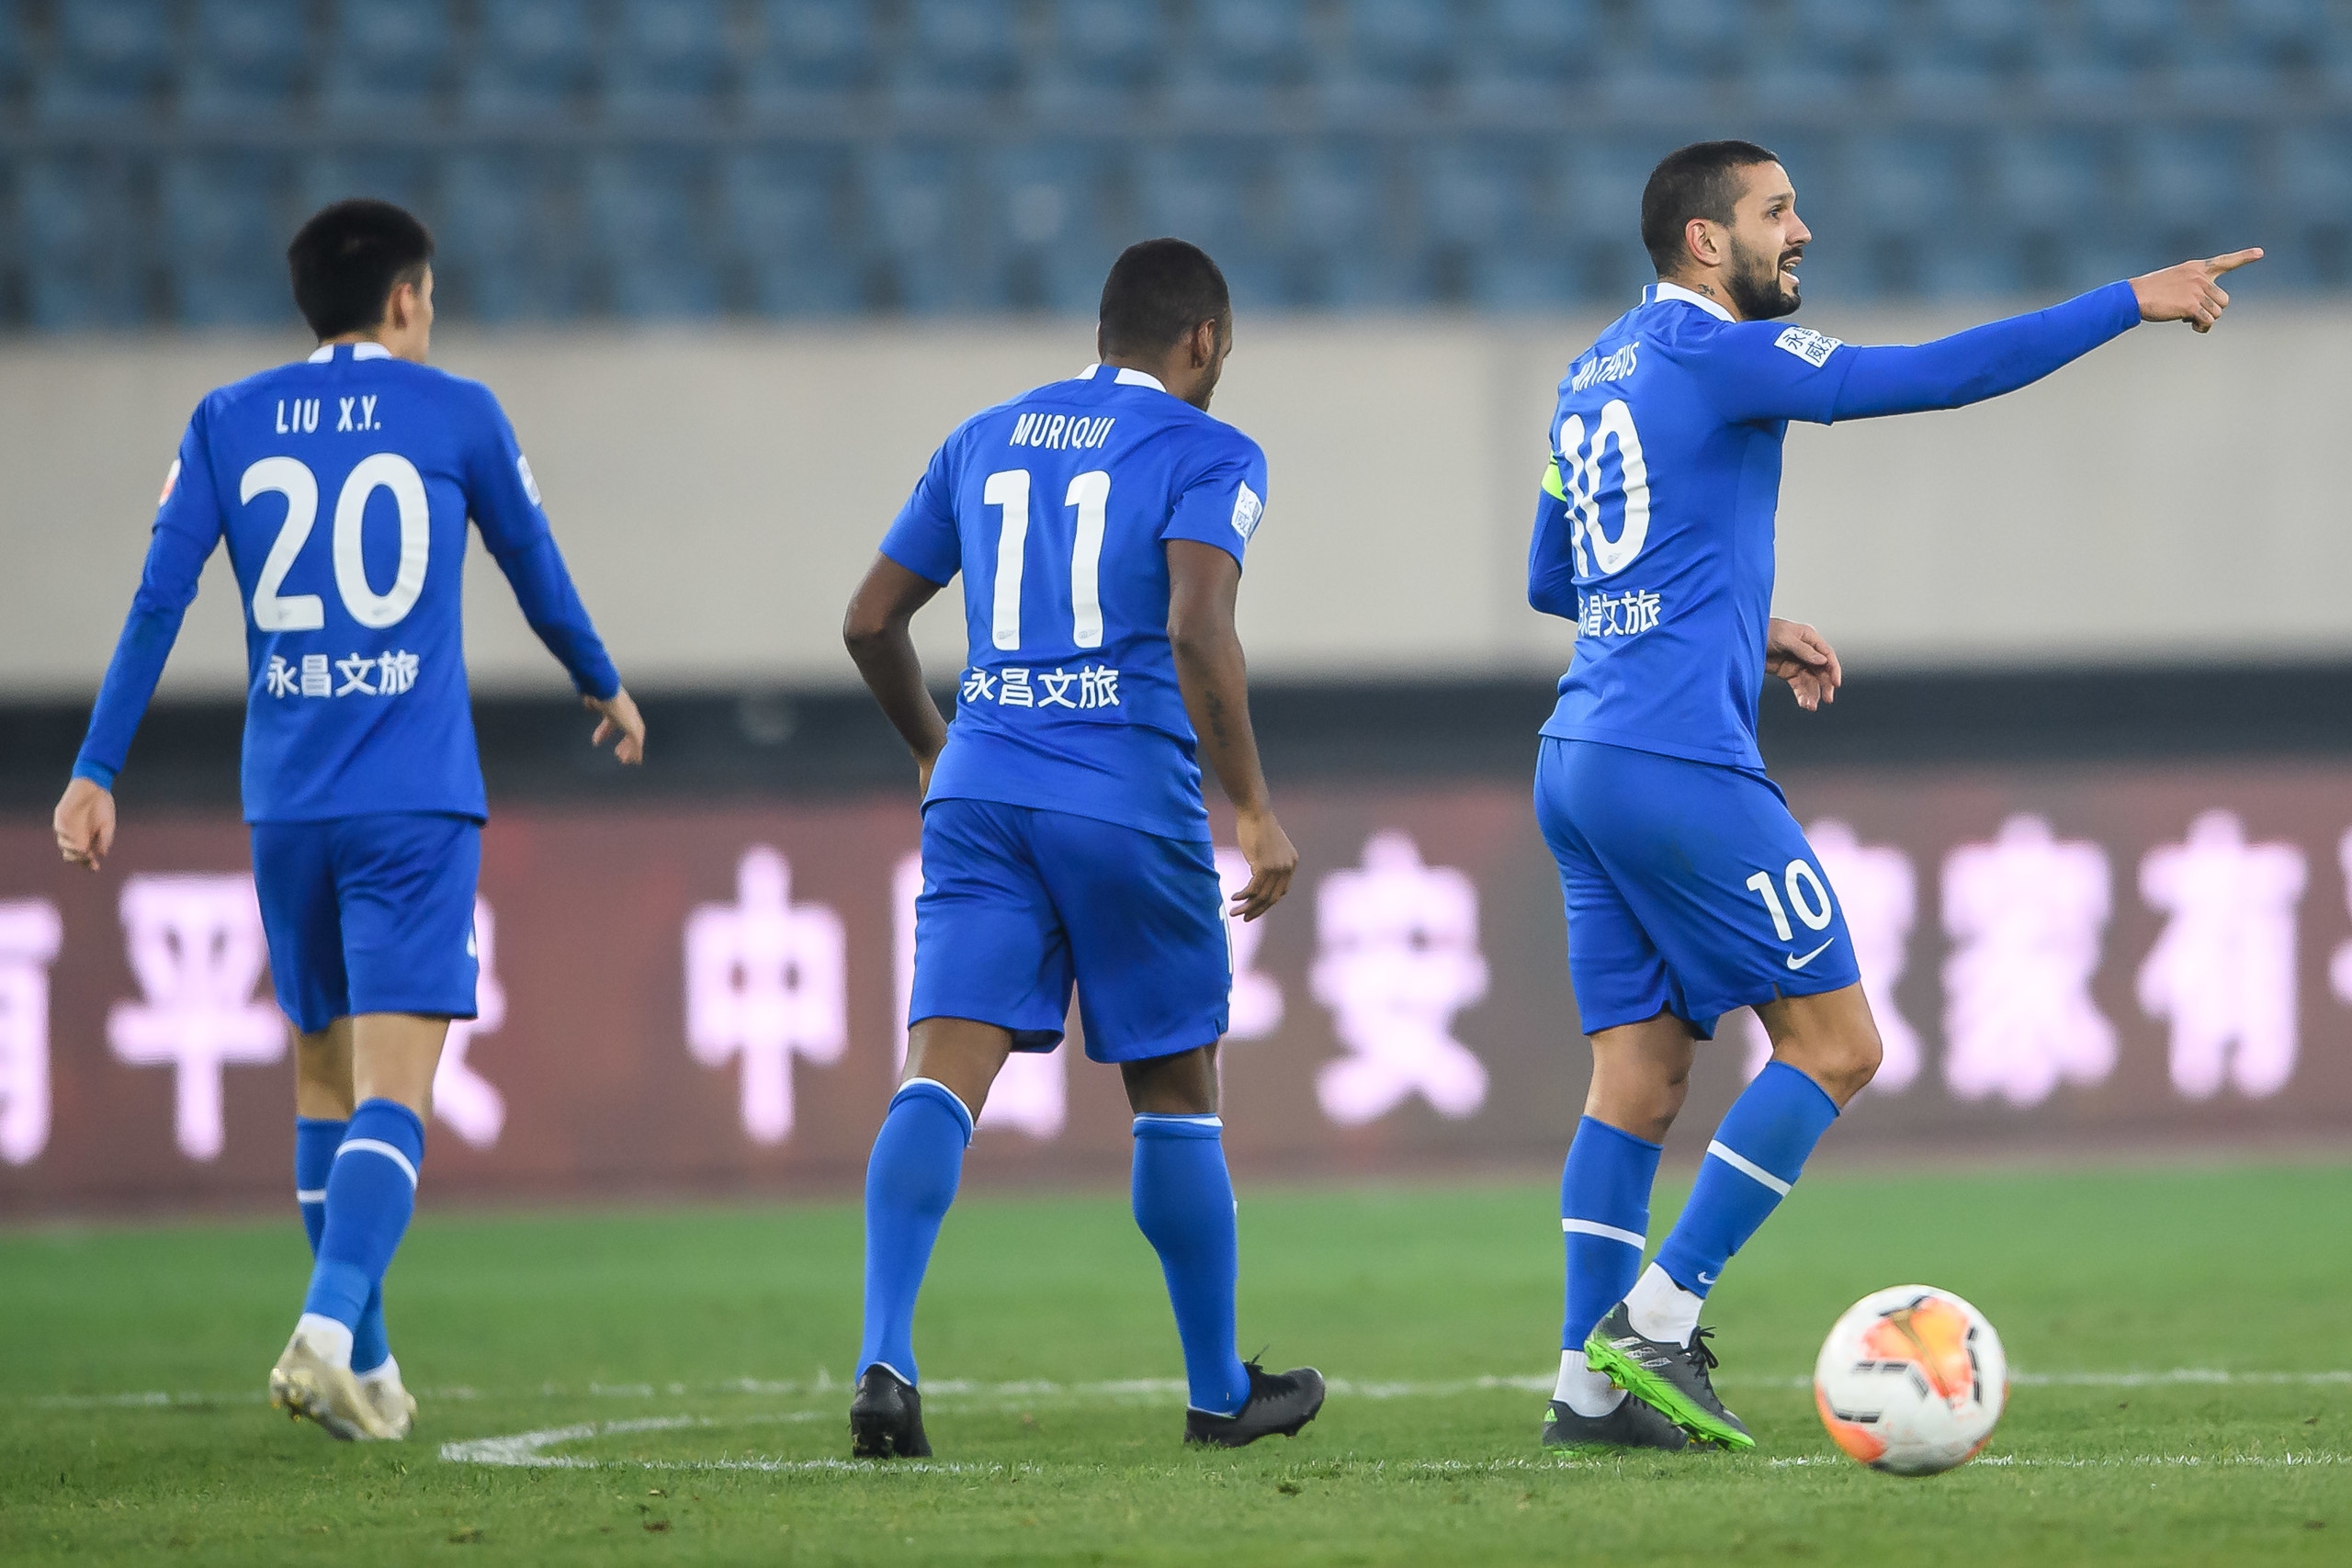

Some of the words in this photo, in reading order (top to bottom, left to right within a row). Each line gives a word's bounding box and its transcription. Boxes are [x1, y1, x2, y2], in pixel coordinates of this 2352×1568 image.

[1571, 341, 1640, 395] MATHEUS
[276, 398, 320, 434] LIU
[337, 395, 381, 432] X.Y.
[1009, 412, 1116, 450] MURIQUI
[1558, 398, 1651, 578] 10
[239, 452, 431, 633] 20
[983, 468, 1112, 651] 11
[266, 649, 420, 698] 永昌文旅
[963, 664, 1121, 709] 永昌文旅
[1746, 858, 1832, 942] 10
